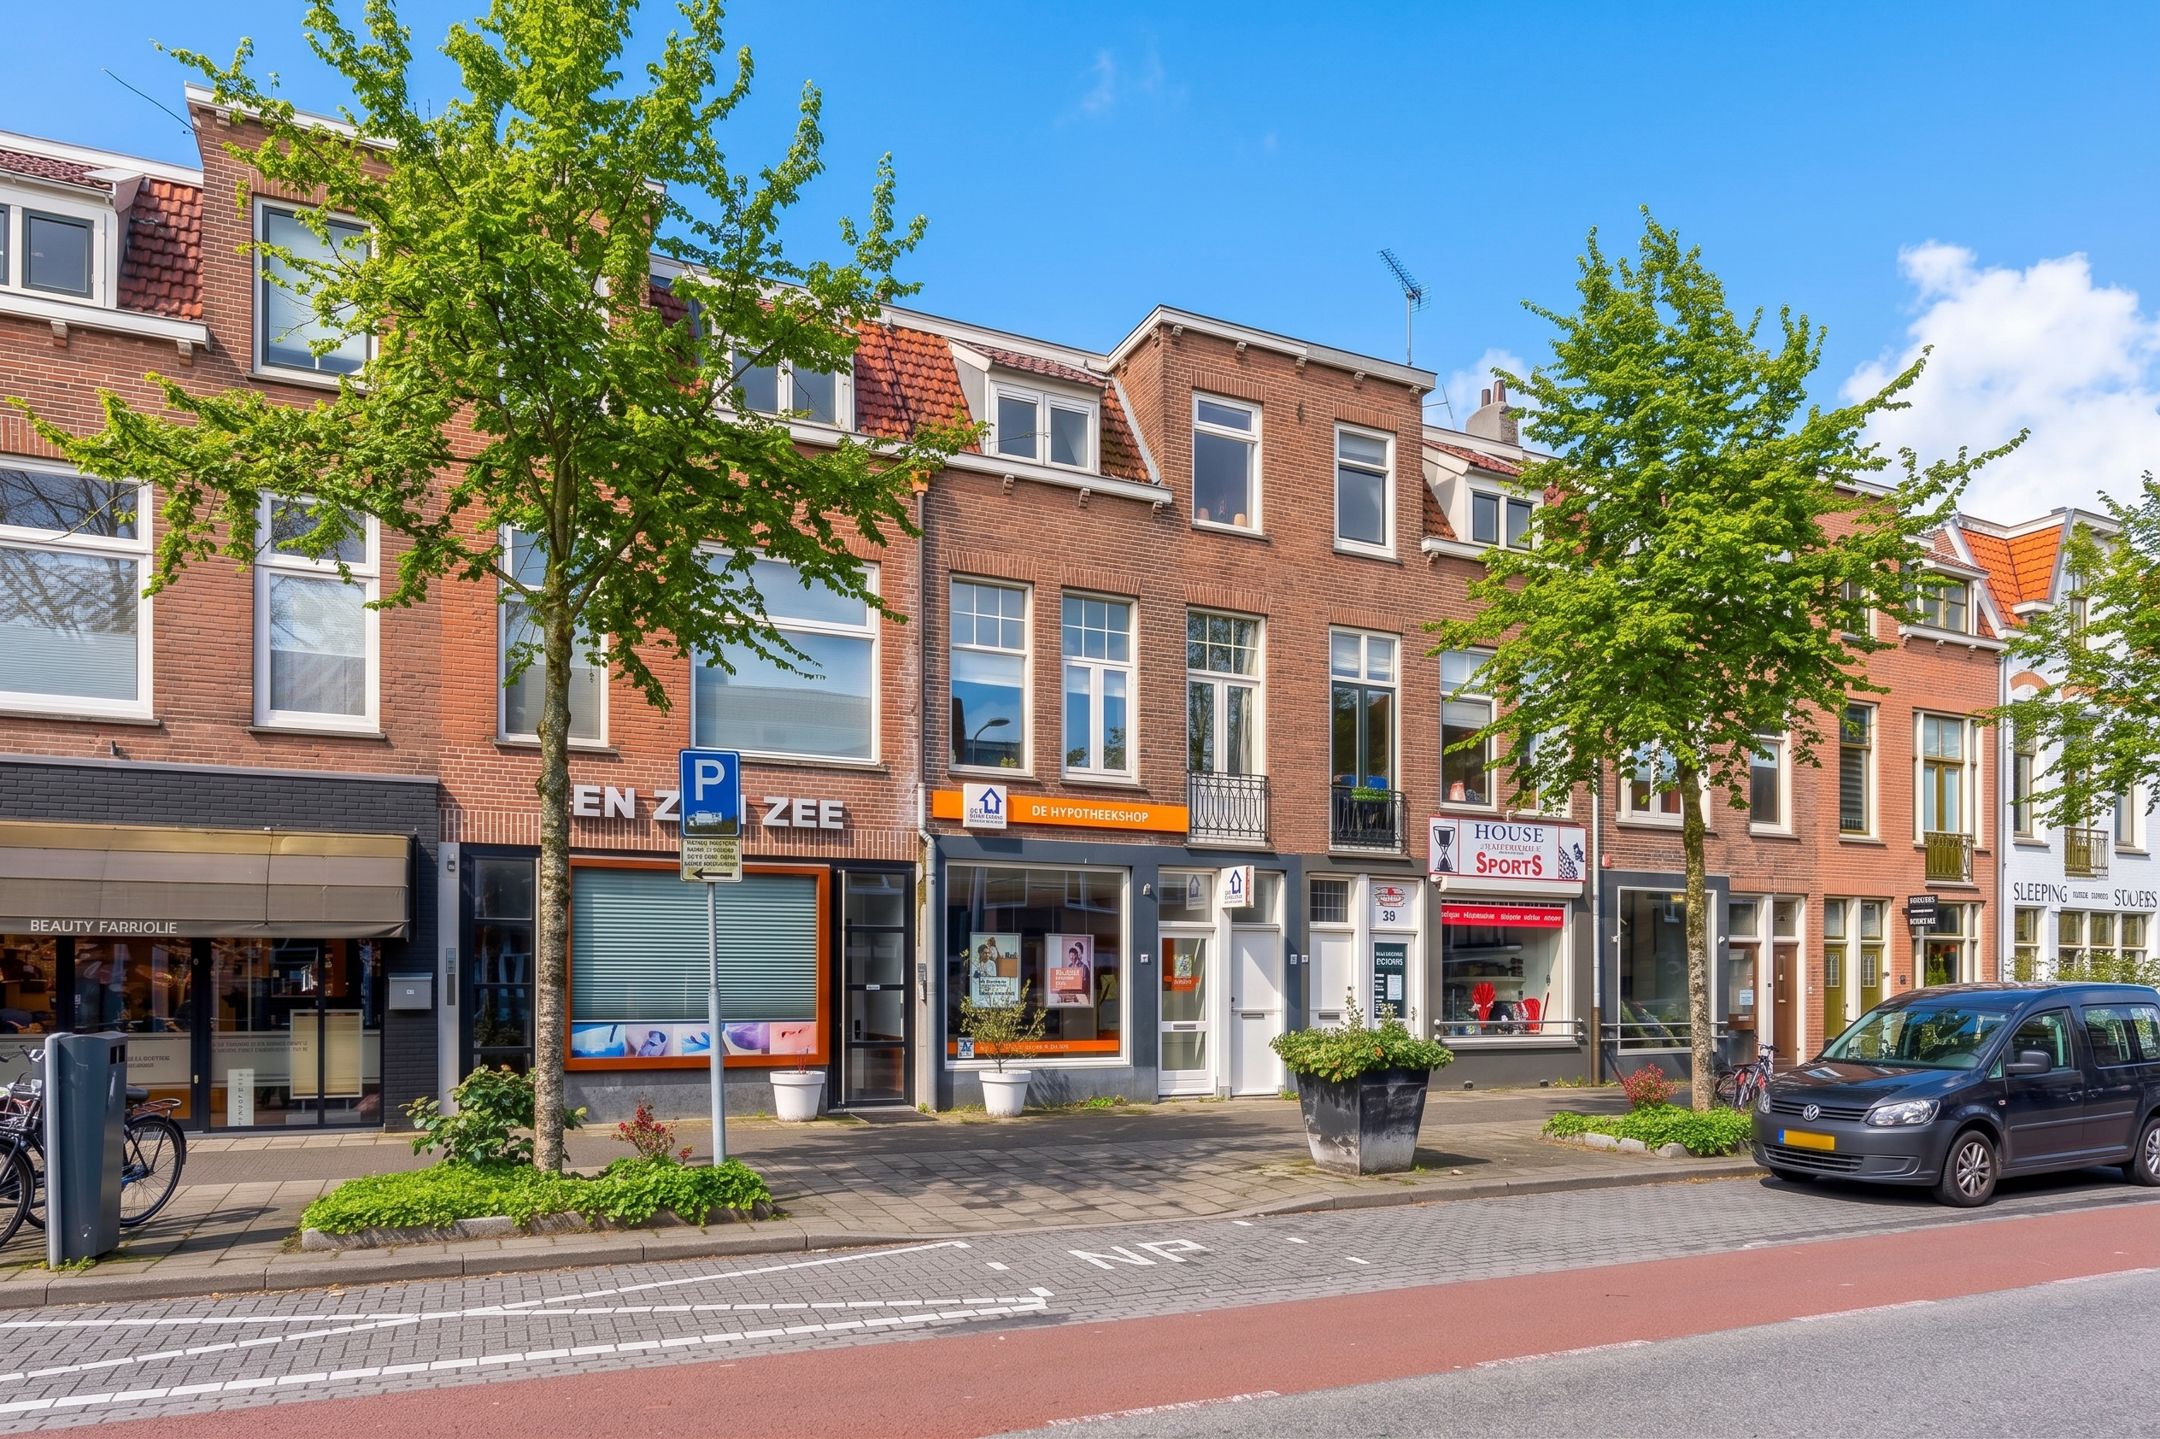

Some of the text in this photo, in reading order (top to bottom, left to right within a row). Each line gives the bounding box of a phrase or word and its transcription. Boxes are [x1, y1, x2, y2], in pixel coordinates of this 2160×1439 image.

[694, 759, 726, 801] P
[569, 784, 636, 819] EN
[762, 796, 844, 830] ZEE
[1031, 805, 1150, 823] DE HYPOTHEEKSHOP
[1474, 823, 1544, 843] HOUSE
[1475, 851, 1543, 877] SPORTS
[2013, 881, 2068, 903] SLEEPING
[30, 919, 94, 933] BEAUTY
